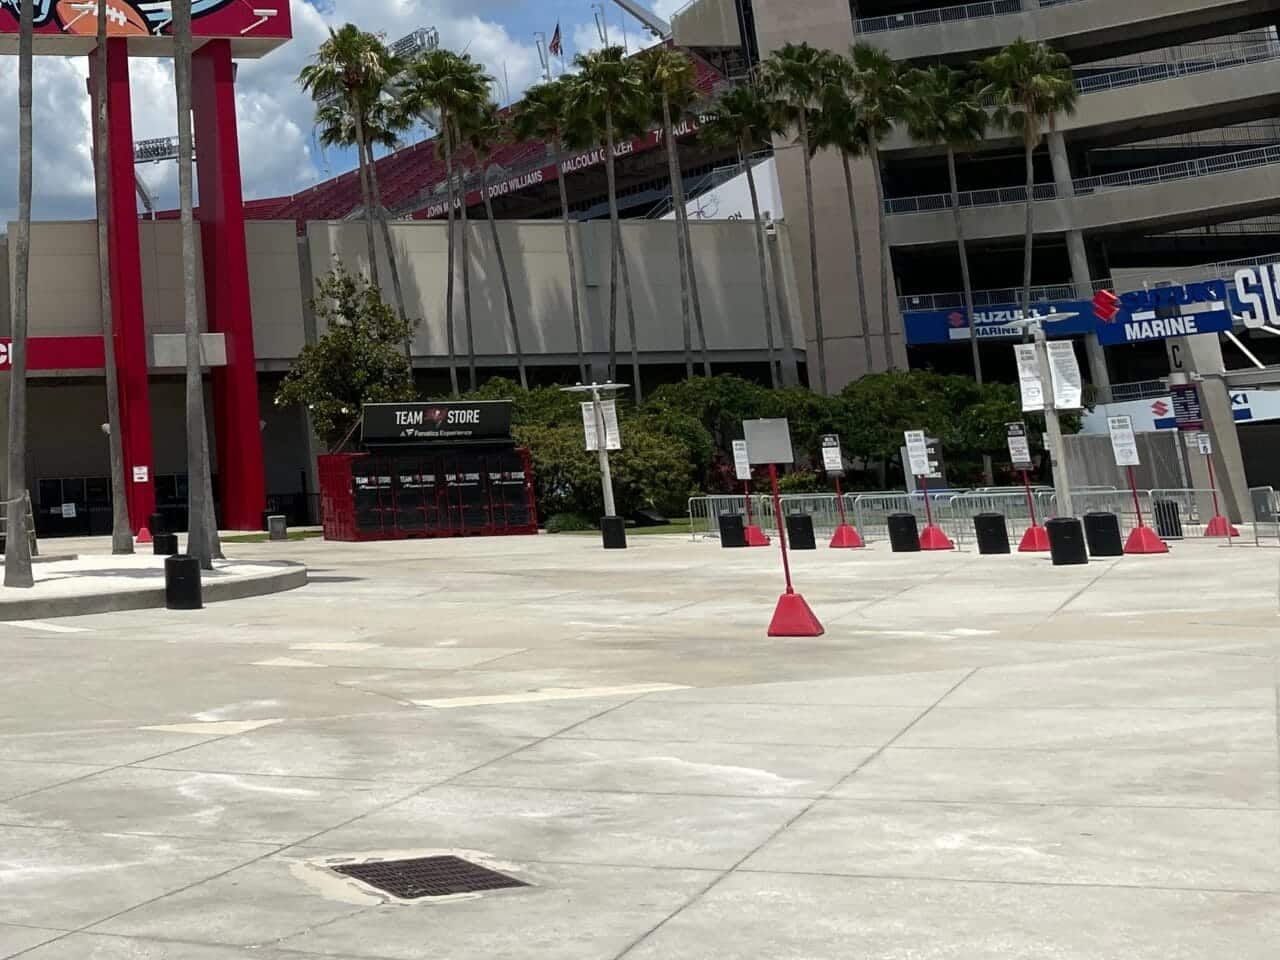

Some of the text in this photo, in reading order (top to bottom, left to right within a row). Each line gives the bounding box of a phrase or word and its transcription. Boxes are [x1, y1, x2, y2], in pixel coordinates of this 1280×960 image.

[600, 142, 633, 161] GAZER
[487, 182, 508, 198] DOUG
[509, 170, 543, 192] WILLIAMS
[427, 201, 443, 218] JOHN
[1124, 315, 1198, 341] MARINE
[1172, 345, 1182, 368] C
[396, 409, 480, 425] TEAM STORE
